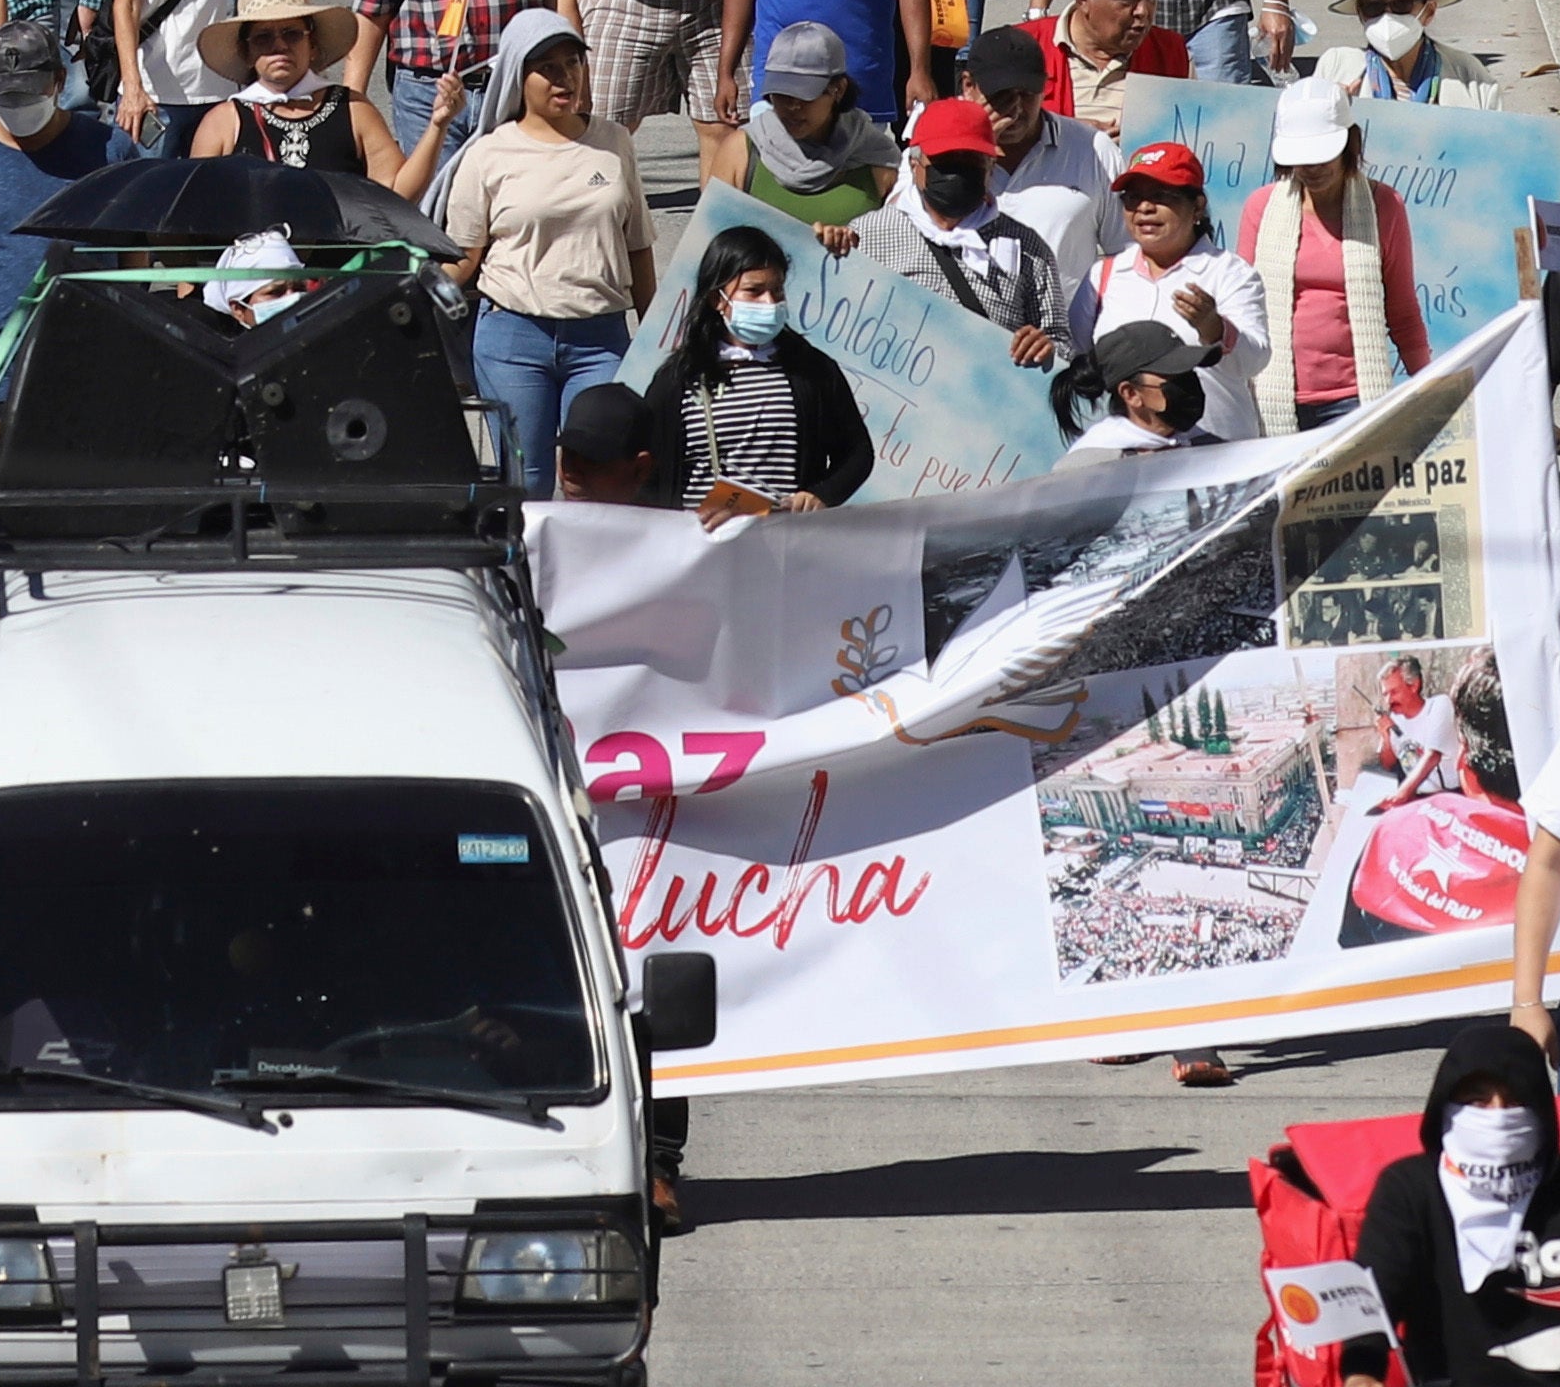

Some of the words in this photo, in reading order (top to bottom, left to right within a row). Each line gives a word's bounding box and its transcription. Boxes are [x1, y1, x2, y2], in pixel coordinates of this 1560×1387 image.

[798, 250, 936, 387] Soldado
[879, 403, 913, 468] tu
[1291, 458, 1386, 510] Firmada
[1393, 455, 1416, 490] la
[1425, 457, 1468, 495] paz
[617, 768, 932, 951] lucha
